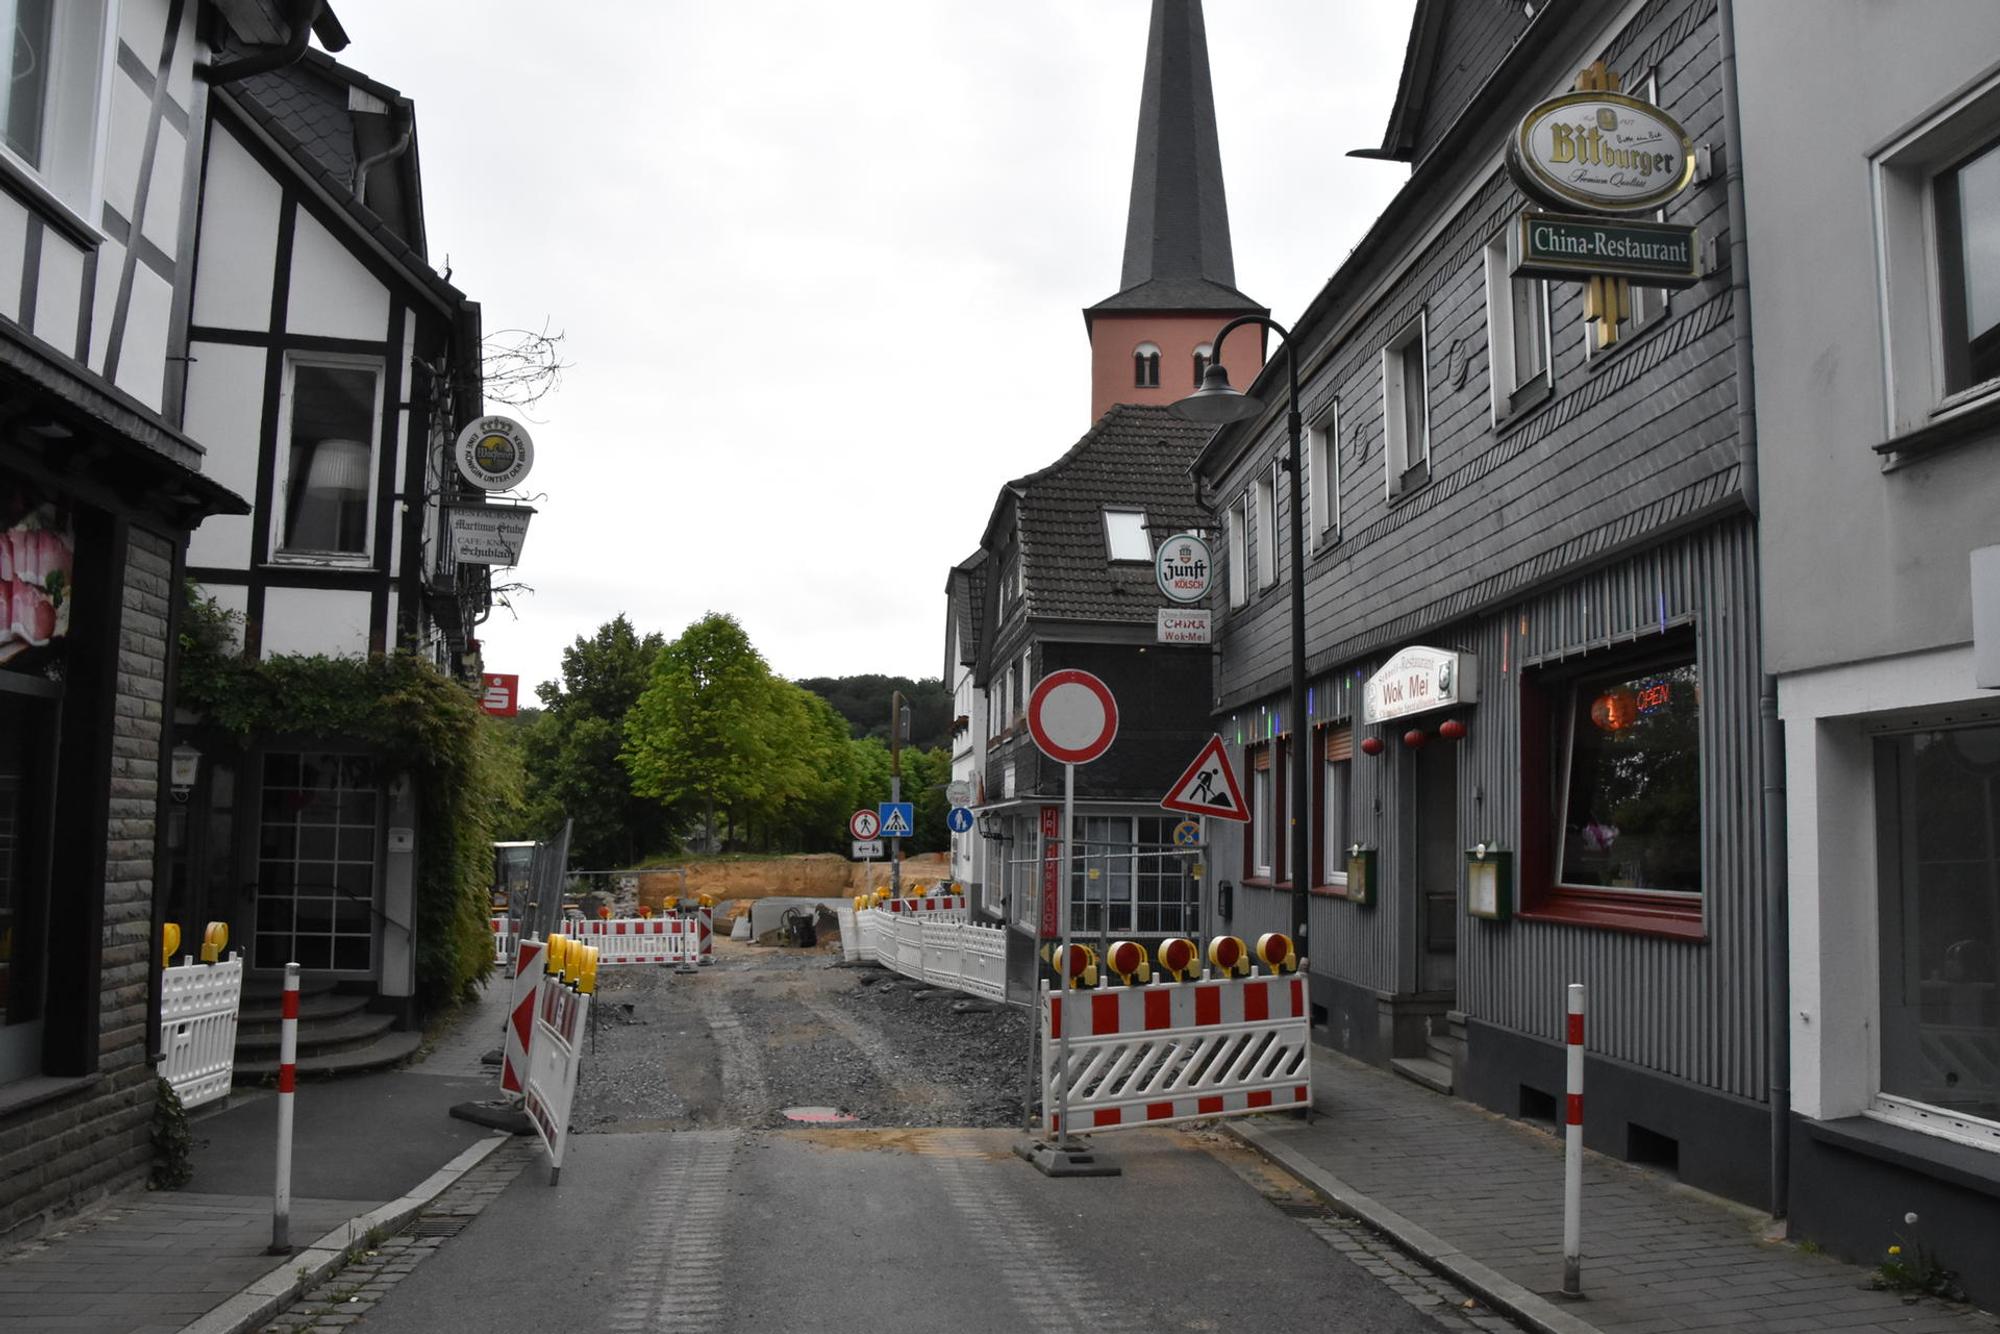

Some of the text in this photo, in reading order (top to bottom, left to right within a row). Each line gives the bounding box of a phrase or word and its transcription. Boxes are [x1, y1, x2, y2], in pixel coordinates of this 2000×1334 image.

[1549, 122, 1674, 177] Bitburger
[1568, 168, 1609, 185] Premium
[1534, 226, 1688, 263] China-Restaurant
[510, 462, 524, 478] DEN
[1163, 558, 1207, 581] Zunft
[1174, 578, 1204, 589] KÖLSCH
[1163, 620, 1206, 630] CHINA
[1382, 681, 1404, 705] Wok
[1409, 672, 1429, 699] Mei
[1636, 685, 1669, 709] OPEN
